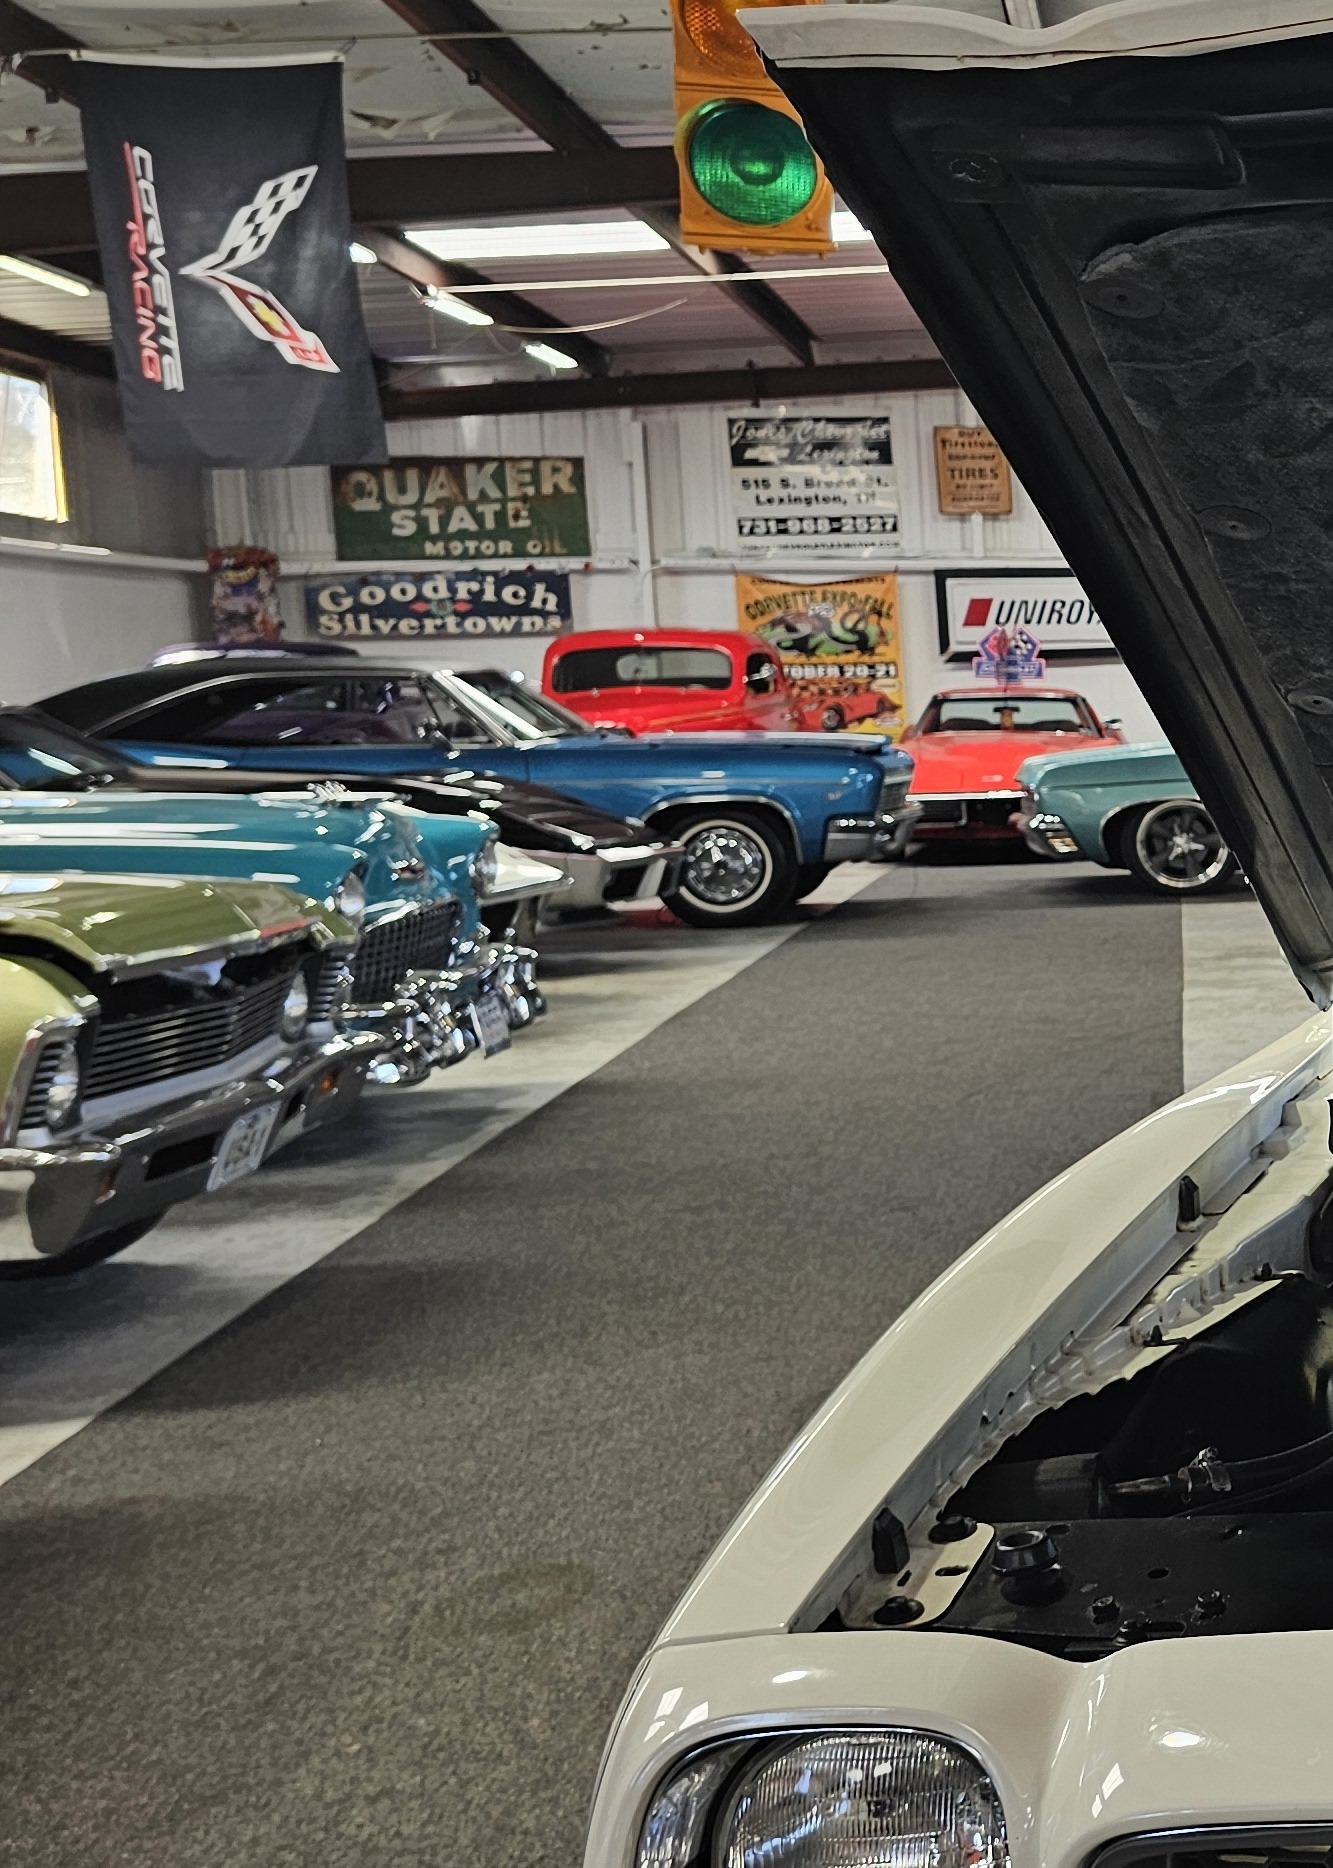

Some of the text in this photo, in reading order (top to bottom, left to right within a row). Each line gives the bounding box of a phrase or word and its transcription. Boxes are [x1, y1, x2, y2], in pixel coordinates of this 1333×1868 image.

[124, 141, 162, 383] RACING
[132, 145, 184, 392] CORVETTE
[341, 458, 577, 512] QUAKER
[949, 467, 999, 480] TIRES
[391, 502, 531, 536] STATE
[424, 539, 568, 557] MOTOR OIL
[318, 574, 559, 613] Goodrich
[744, 589, 817, 621] CORVETTE
[318, 611, 563, 637] Silvertowns
[995, 598, 1102, 625] UNIROY
